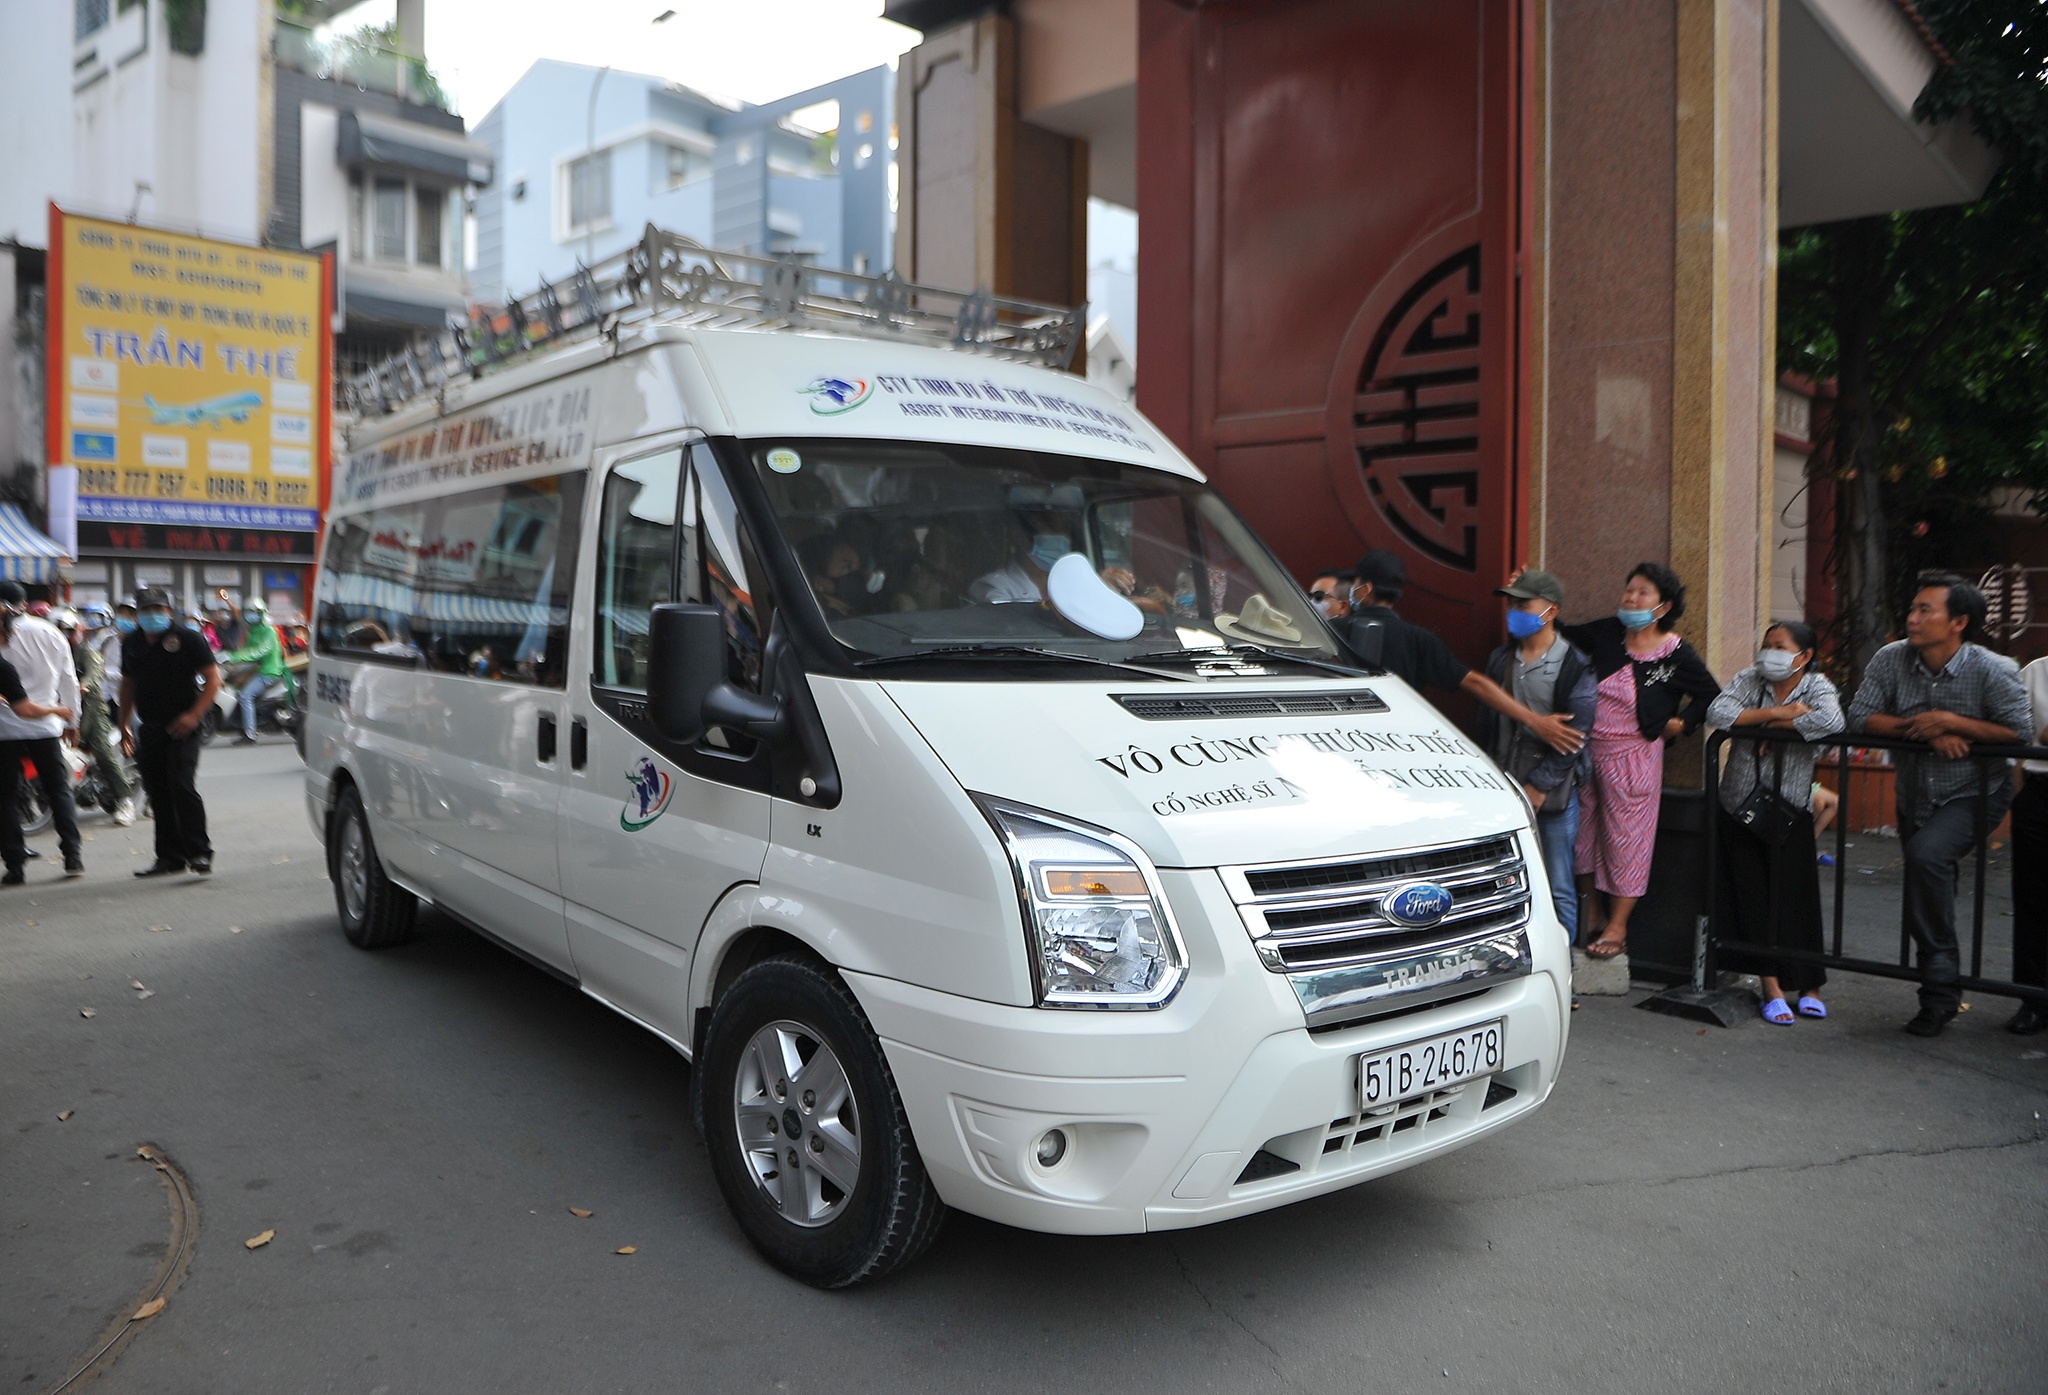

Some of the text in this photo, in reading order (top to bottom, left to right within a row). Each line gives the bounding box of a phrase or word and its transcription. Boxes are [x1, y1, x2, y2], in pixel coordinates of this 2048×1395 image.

[875, 375, 914, 395] CTY
[911, 377, 960, 398] TNHH
[955, 380, 982, 400] DV
[898, 402, 949, 418] ASSIST
[947, 405, 1070, 433] INTERCONTINENTAL
[1095, 744, 1165, 781] VÔ
[1169, 733, 1281, 769] CÙNG
[1408, 728, 1481, 759] TIẾC
[1151, 790, 1186, 817] CỐ
[1186, 782, 1252, 811] NGHỆ
[1251, 778, 1277, 800] SĨ
[1408, 763, 1466, 790] CHÍ
[1455, 763, 1508, 793] TÀI
[807, 823, 822, 838] LX
[1405, 888, 1444, 917] Ford
[1382, 951, 1475, 991] TRANSIT
[1365, 1028, 1500, 1104] 51B-246.78
